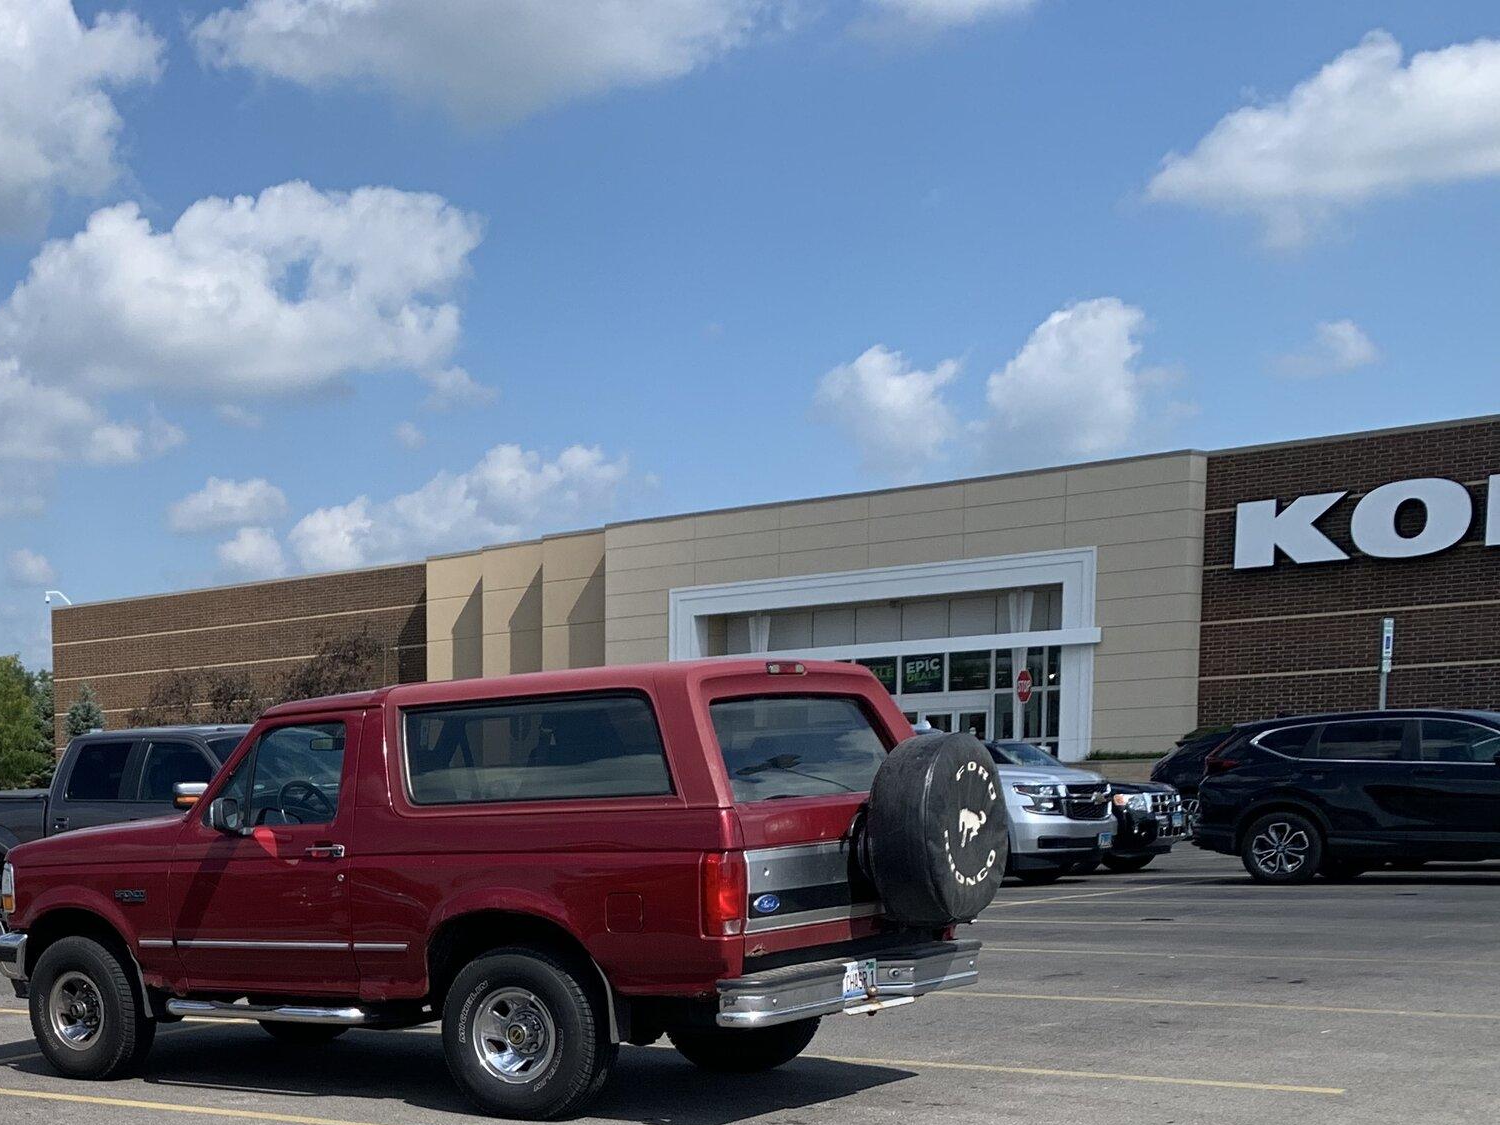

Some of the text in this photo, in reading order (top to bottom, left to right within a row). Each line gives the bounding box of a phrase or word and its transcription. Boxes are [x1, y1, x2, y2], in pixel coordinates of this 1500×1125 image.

[1233, 474, 1500, 570] KO
[906, 658, 941, 674] EPIC
[1017, 680, 1031, 693] STOP
[956, 761, 997, 801] FORD
[458, 980, 489, 1044] MICHELIN
